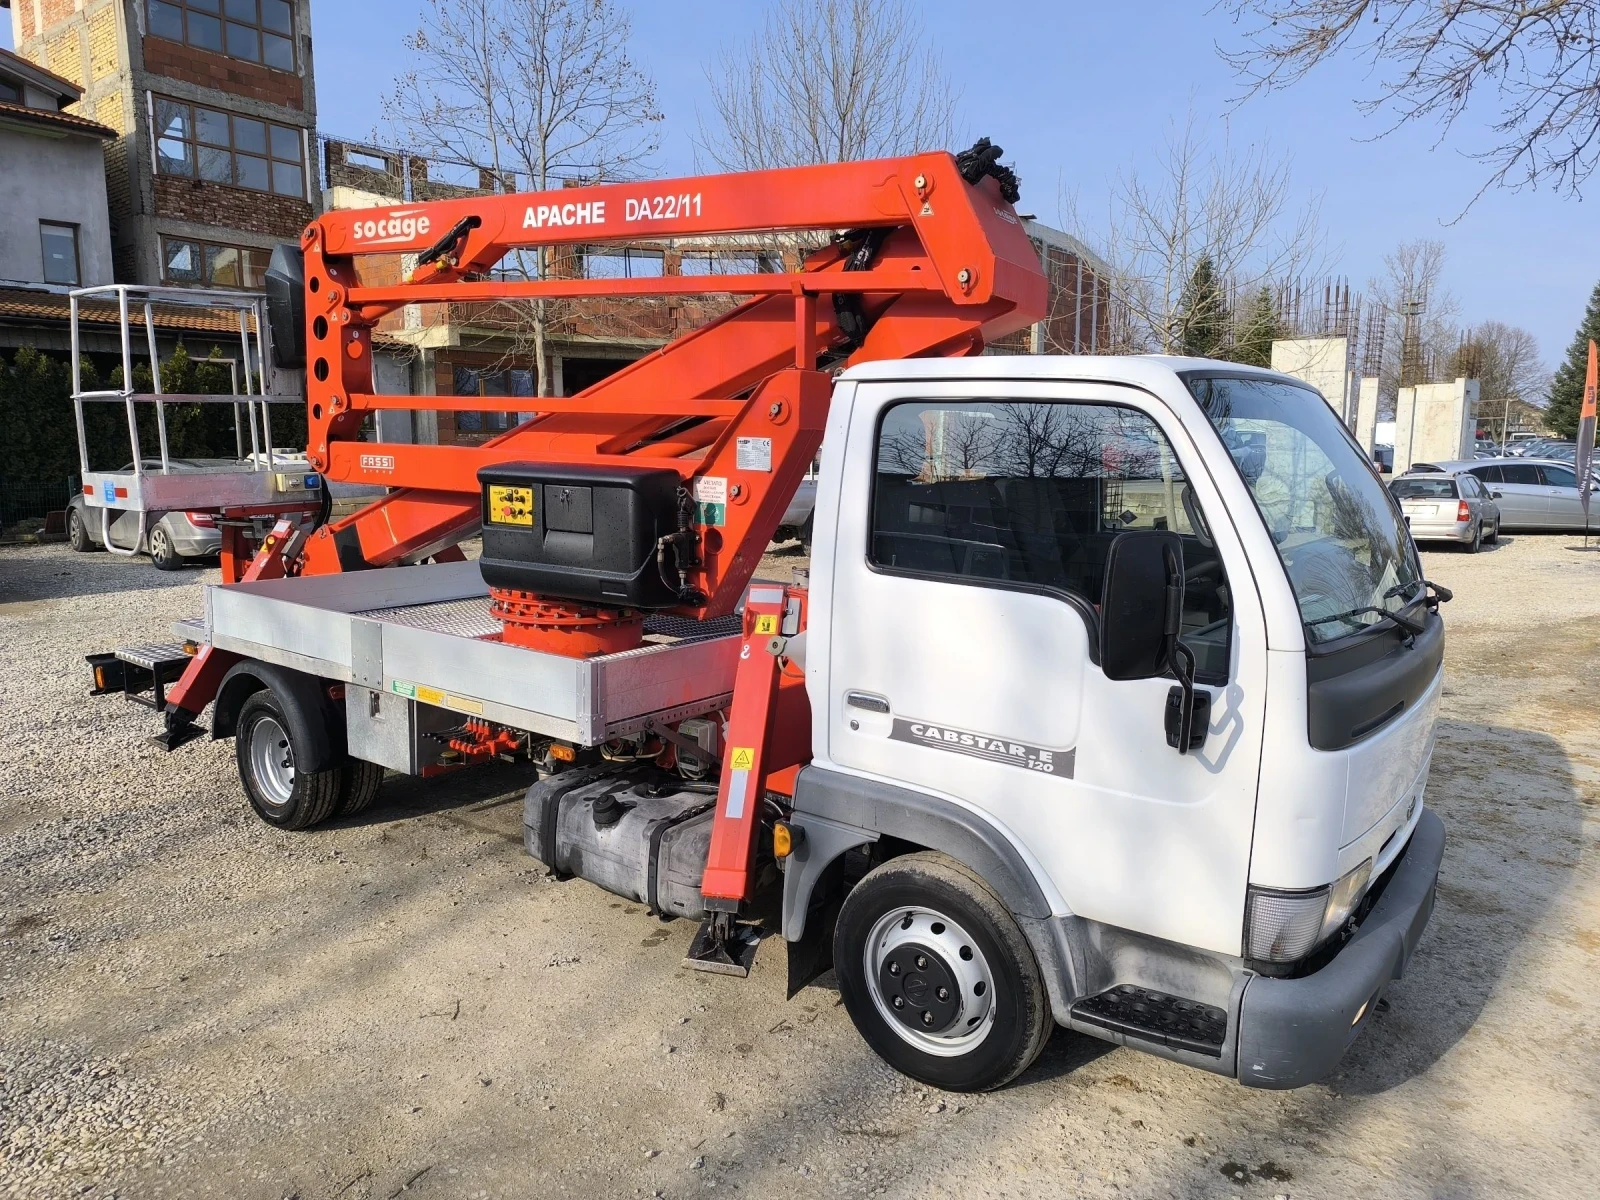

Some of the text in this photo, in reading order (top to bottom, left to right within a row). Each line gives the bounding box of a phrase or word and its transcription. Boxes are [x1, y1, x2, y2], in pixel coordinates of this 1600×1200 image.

[522, 193, 702, 228] APACHE DA22/11
[353, 215, 431, 244] socage
[362, 457, 392, 467] FASSI
[1027, 759, 1054, 773] 120
